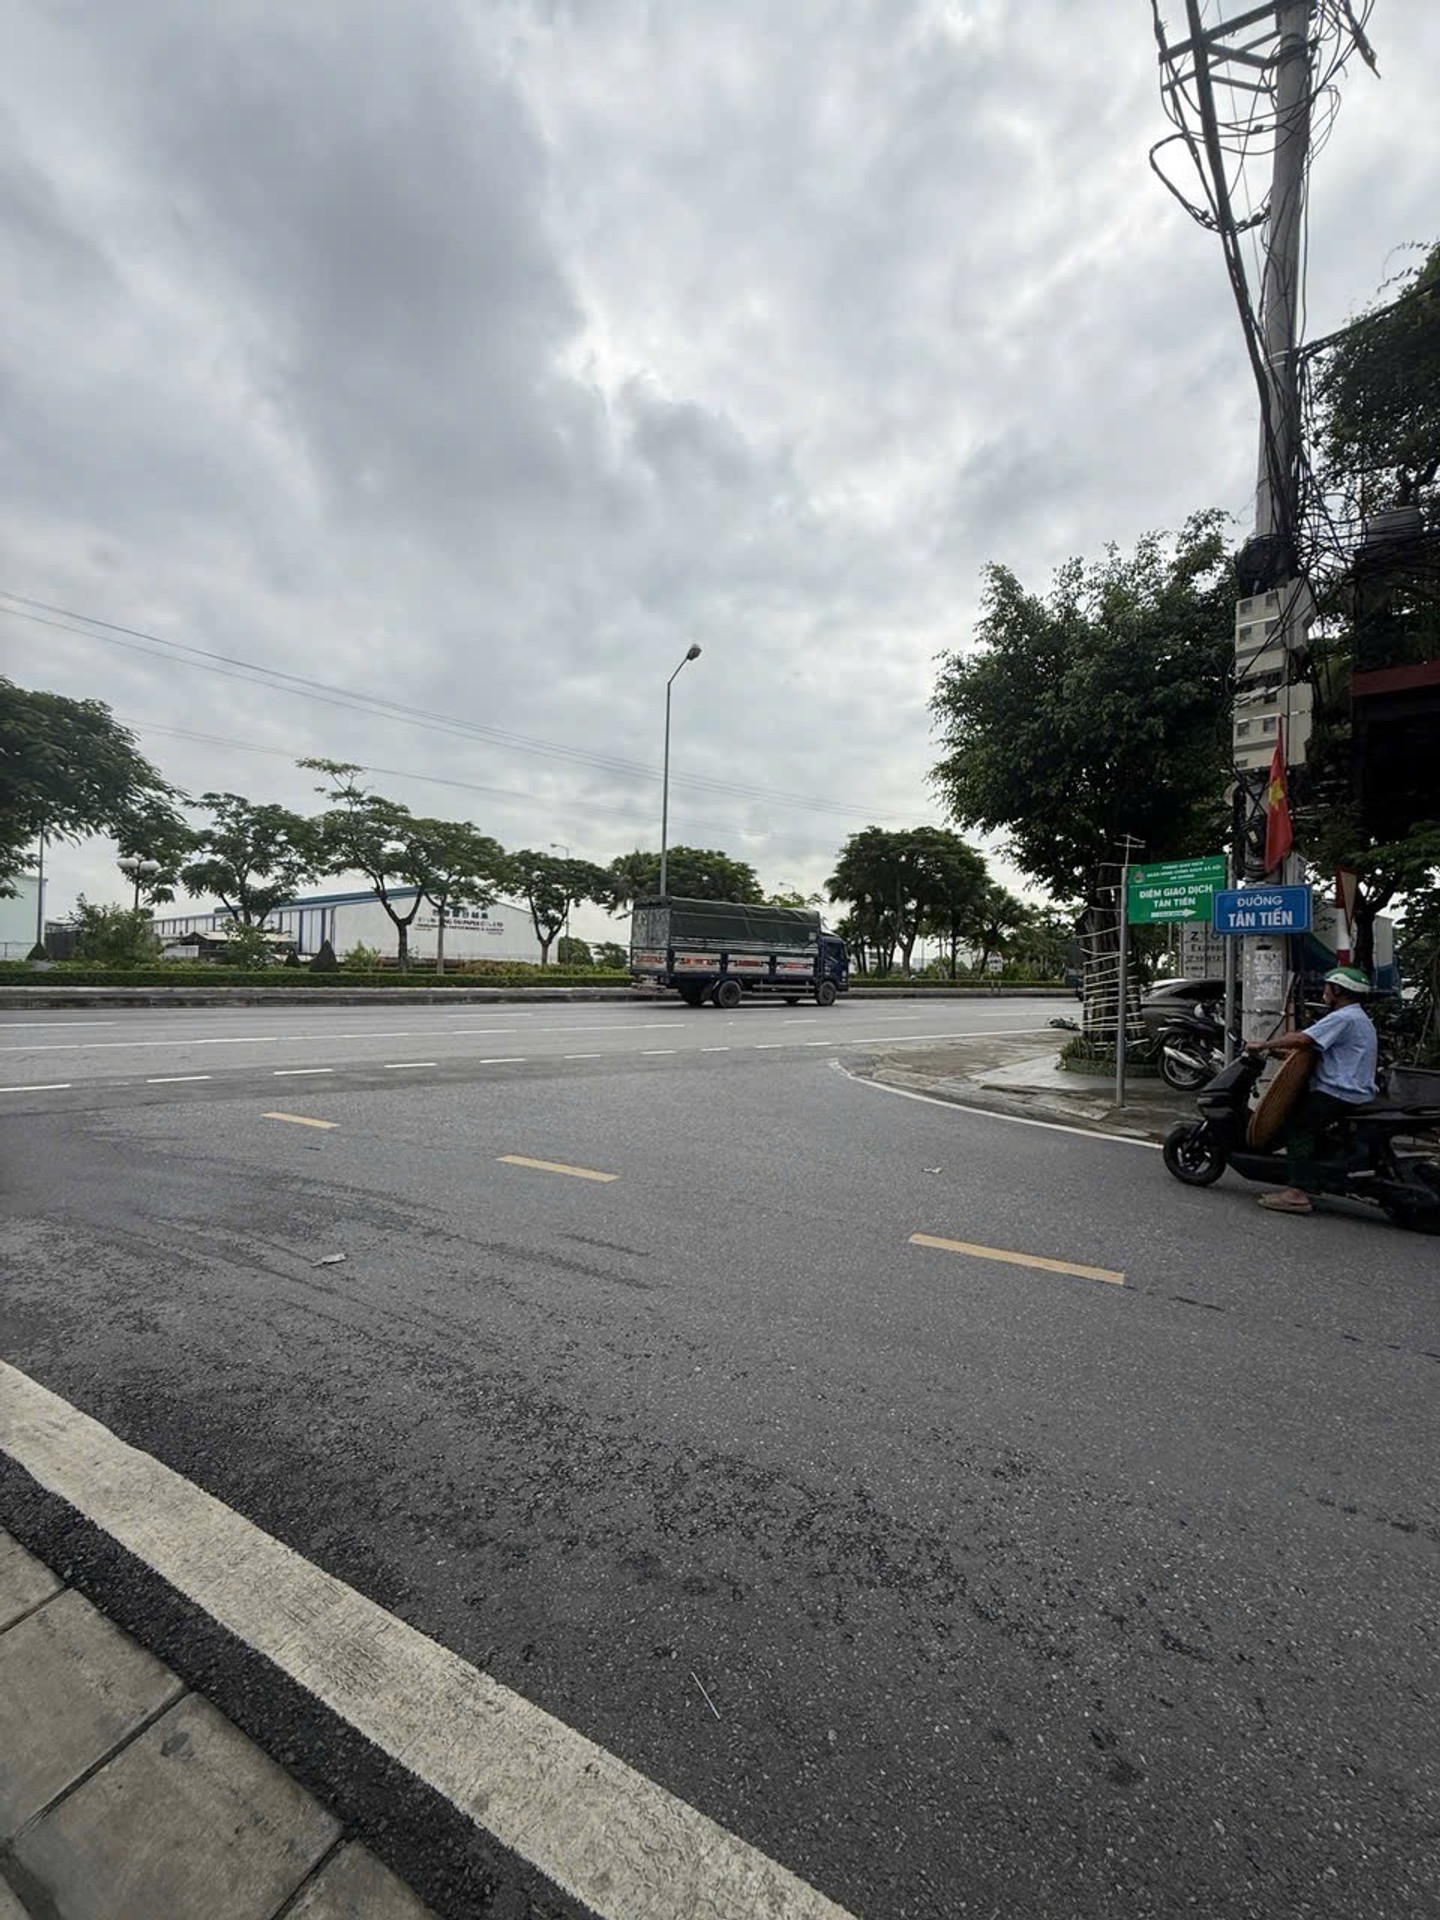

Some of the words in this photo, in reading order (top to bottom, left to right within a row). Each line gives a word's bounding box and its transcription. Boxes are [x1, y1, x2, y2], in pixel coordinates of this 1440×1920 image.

[1163, 886, 1186, 897] GIAO
[1188, 884, 1213, 895] DỊCH
[1237, 895, 1283, 907] ĐƯỜNG
[1228, 909, 1256, 928] TÂN
[1259, 906, 1293, 927] TIẾN
